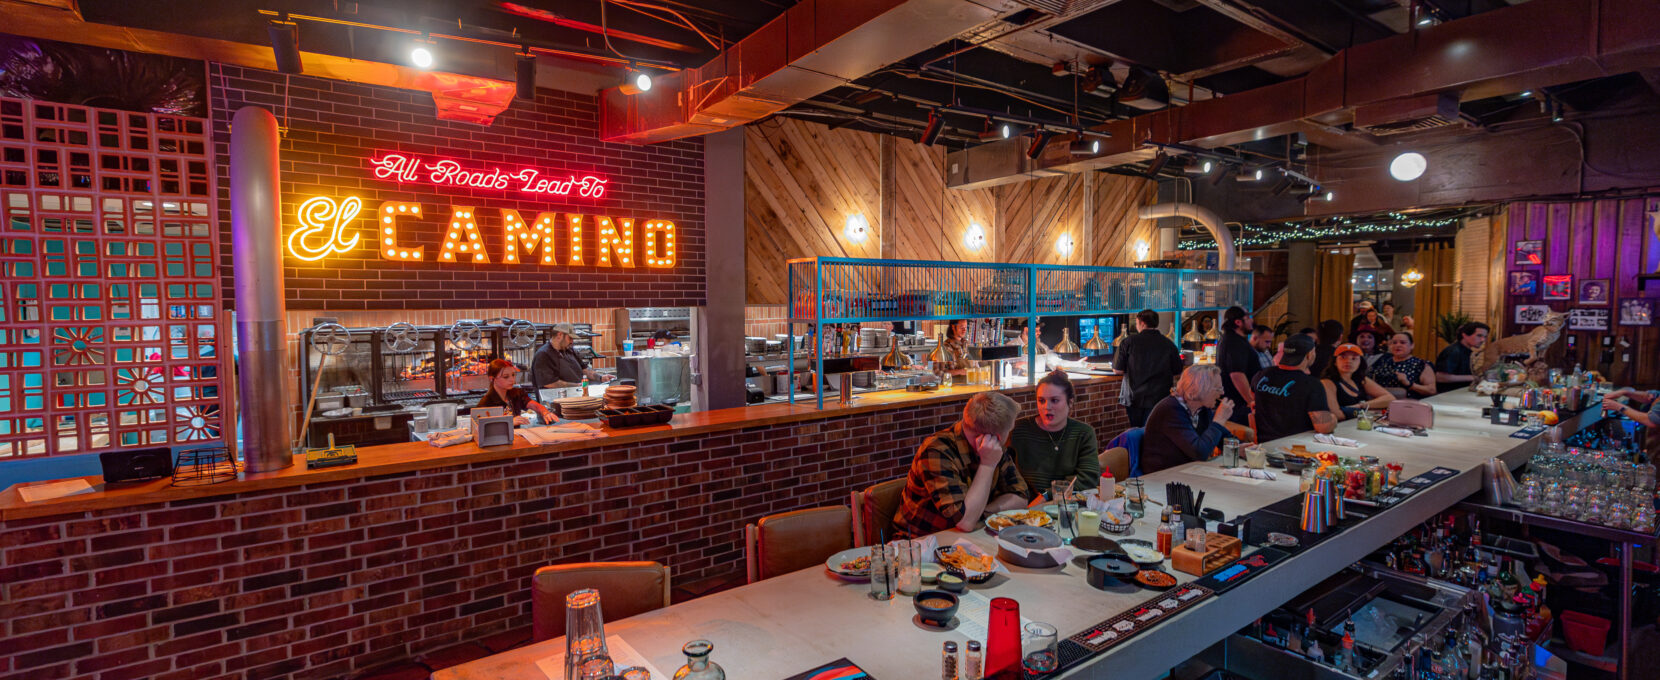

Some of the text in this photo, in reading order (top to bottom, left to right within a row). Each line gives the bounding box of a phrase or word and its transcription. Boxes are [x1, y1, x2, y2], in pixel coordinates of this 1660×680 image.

[371, 154, 608, 198] All Roads Lead To
[287, 196, 677, 269] El CAMINO
[1257, 376, 1296, 397] Coach
